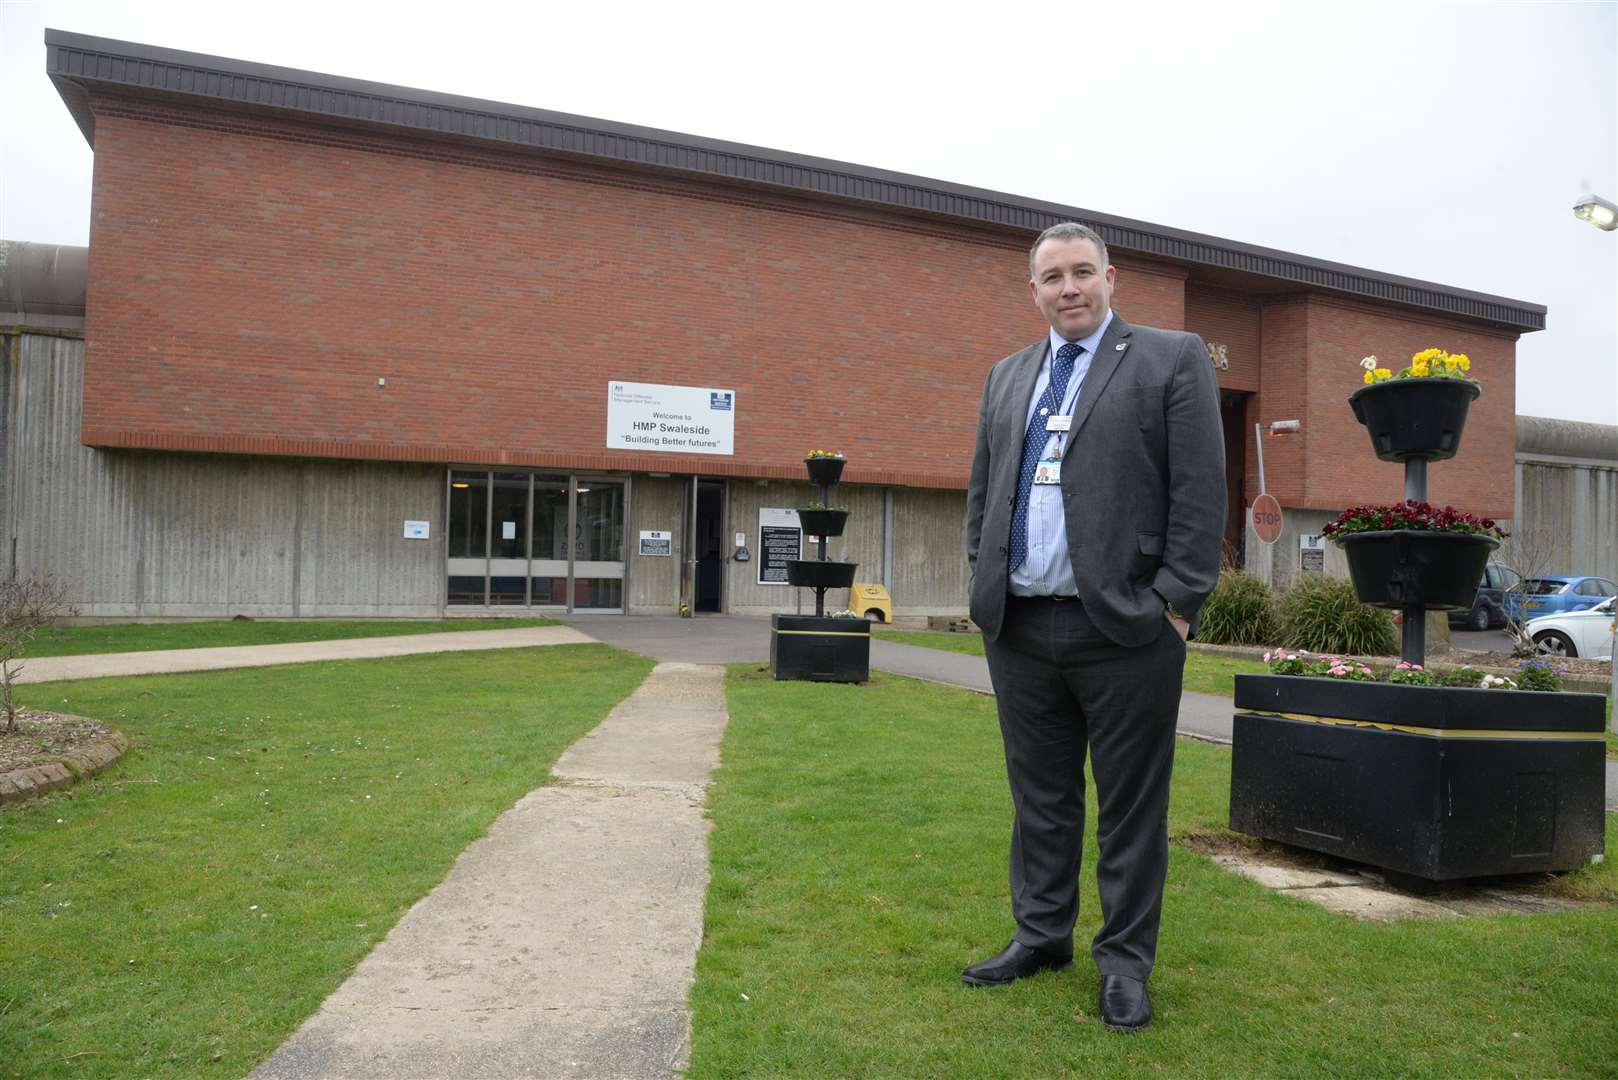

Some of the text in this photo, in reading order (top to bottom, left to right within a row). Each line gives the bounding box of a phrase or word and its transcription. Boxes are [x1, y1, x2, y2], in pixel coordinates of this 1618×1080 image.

[653, 412, 683, 421] Welcome
[633, 421, 710, 434] HMP Swaleside
[621, 435, 660, 445] "Building
[662, 437, 686, 446] Better
[1255, 512, 1281, 525] STOP
